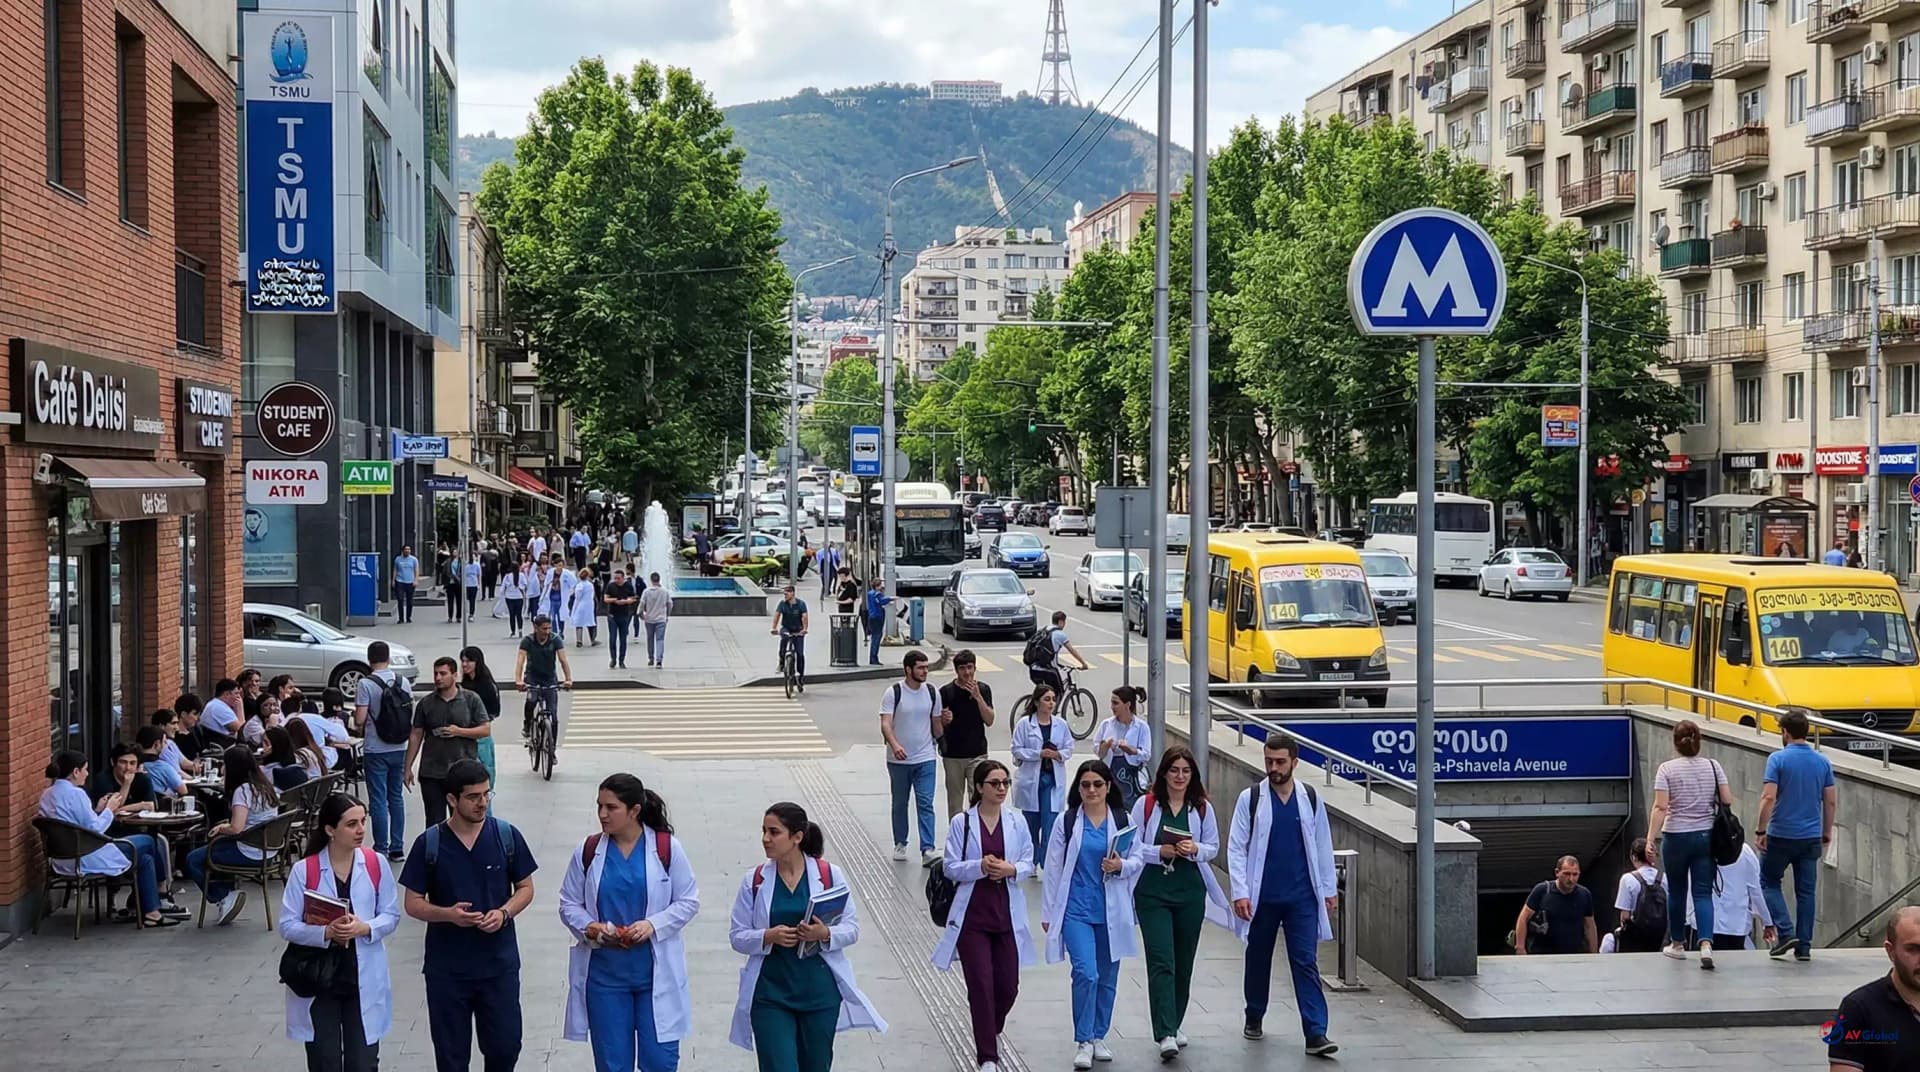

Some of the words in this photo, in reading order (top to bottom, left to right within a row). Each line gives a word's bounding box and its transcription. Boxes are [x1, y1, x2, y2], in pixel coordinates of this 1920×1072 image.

[269, 85, 311, 98] TSMU
[275, 117, 307, 254] TSMU
[1371, 231, 1488, 319] M
[34, 360, 78, 426] Café
[82, 370, 127, 431] Delisi
[263, 405, 325, 420] STUDENT
[201, 421, 224, 447] CAFE
[277, 423, 311, 437] CAFE
[252, 469, 320, 481] NIKORA
[347, 466, 388, 481] ATM
[268, 485, 305, 497] ATM
[1759, 594, 1808, 609] დელისი
[1271, 604, 1297, 619] 140
[1769, 638, 1799, 659] 140
[1398, 757, 1511, 773] Vaa-Pshavela
[1514, 757, 1568, 772] Avenue
